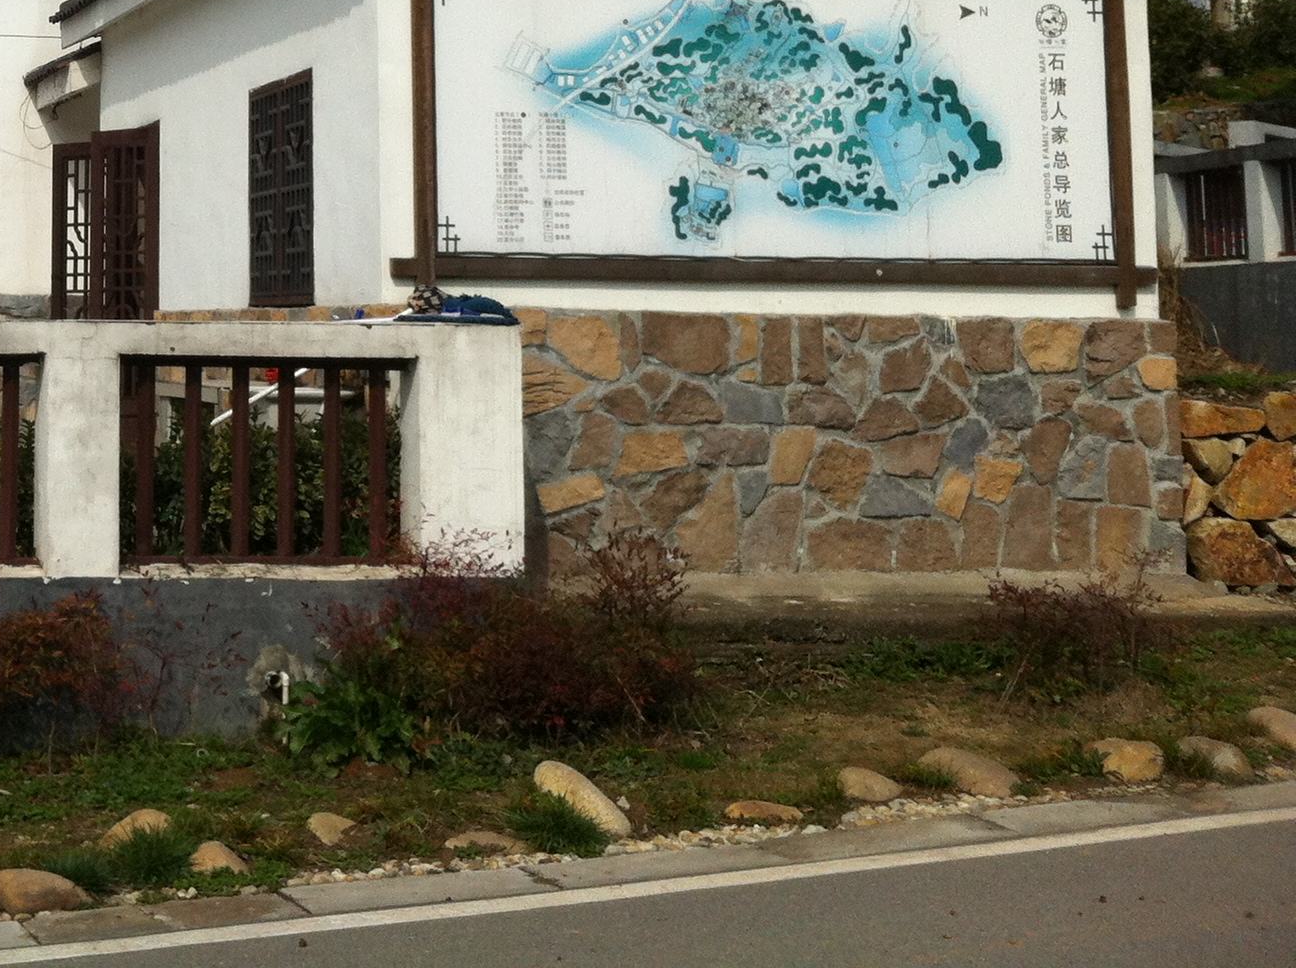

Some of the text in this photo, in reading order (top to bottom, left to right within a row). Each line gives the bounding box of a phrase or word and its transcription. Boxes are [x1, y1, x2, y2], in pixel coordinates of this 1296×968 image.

[979, 5, 989, 17] N
[1038, 53, 1046, 73] MAP
[1039, 77, 1048, 122] GENERAL
[1041, 124, 1050, 160] FAMILY
[1048, 52, 1073, 244] 石塘人家总导览图
[1044, 209, 1053, 242] STONE
